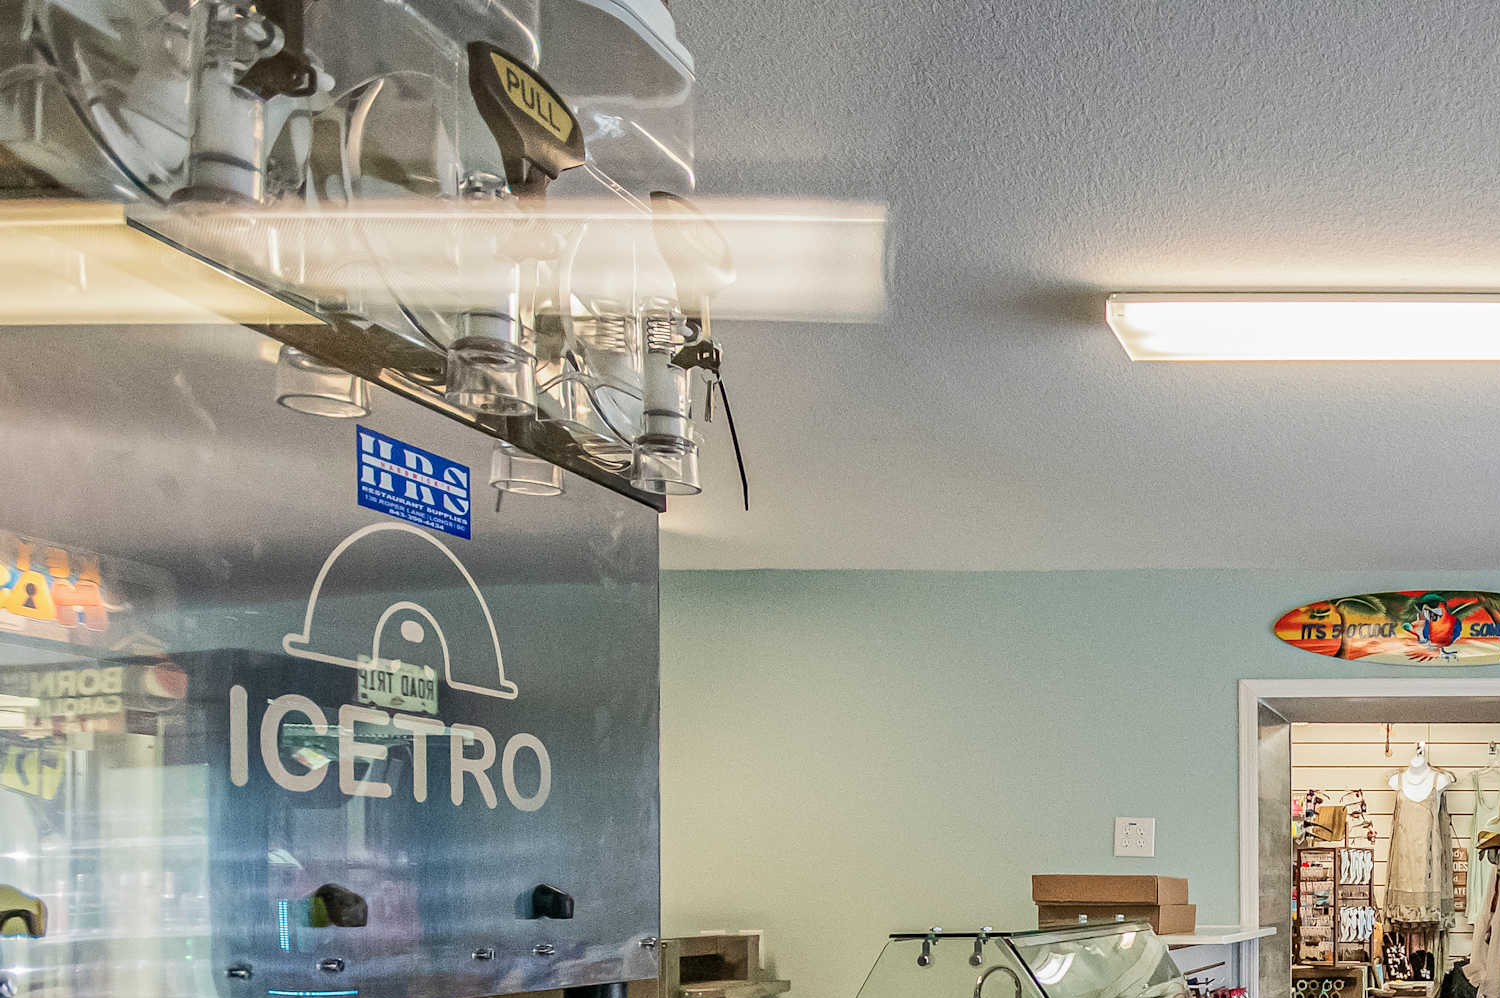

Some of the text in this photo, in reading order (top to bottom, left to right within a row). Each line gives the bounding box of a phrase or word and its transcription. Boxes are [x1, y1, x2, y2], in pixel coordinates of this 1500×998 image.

[505, 66, 563, 132] PULL
[360, 432, 470, 516] HRS
[361, 485, 468, 525] RESTAURANT SUPPLIES
[1301, 623, 1327, 640] IT'S
[1332, 623, 1342, 639] 5
[229, 685, 553, 812] ICETRO
